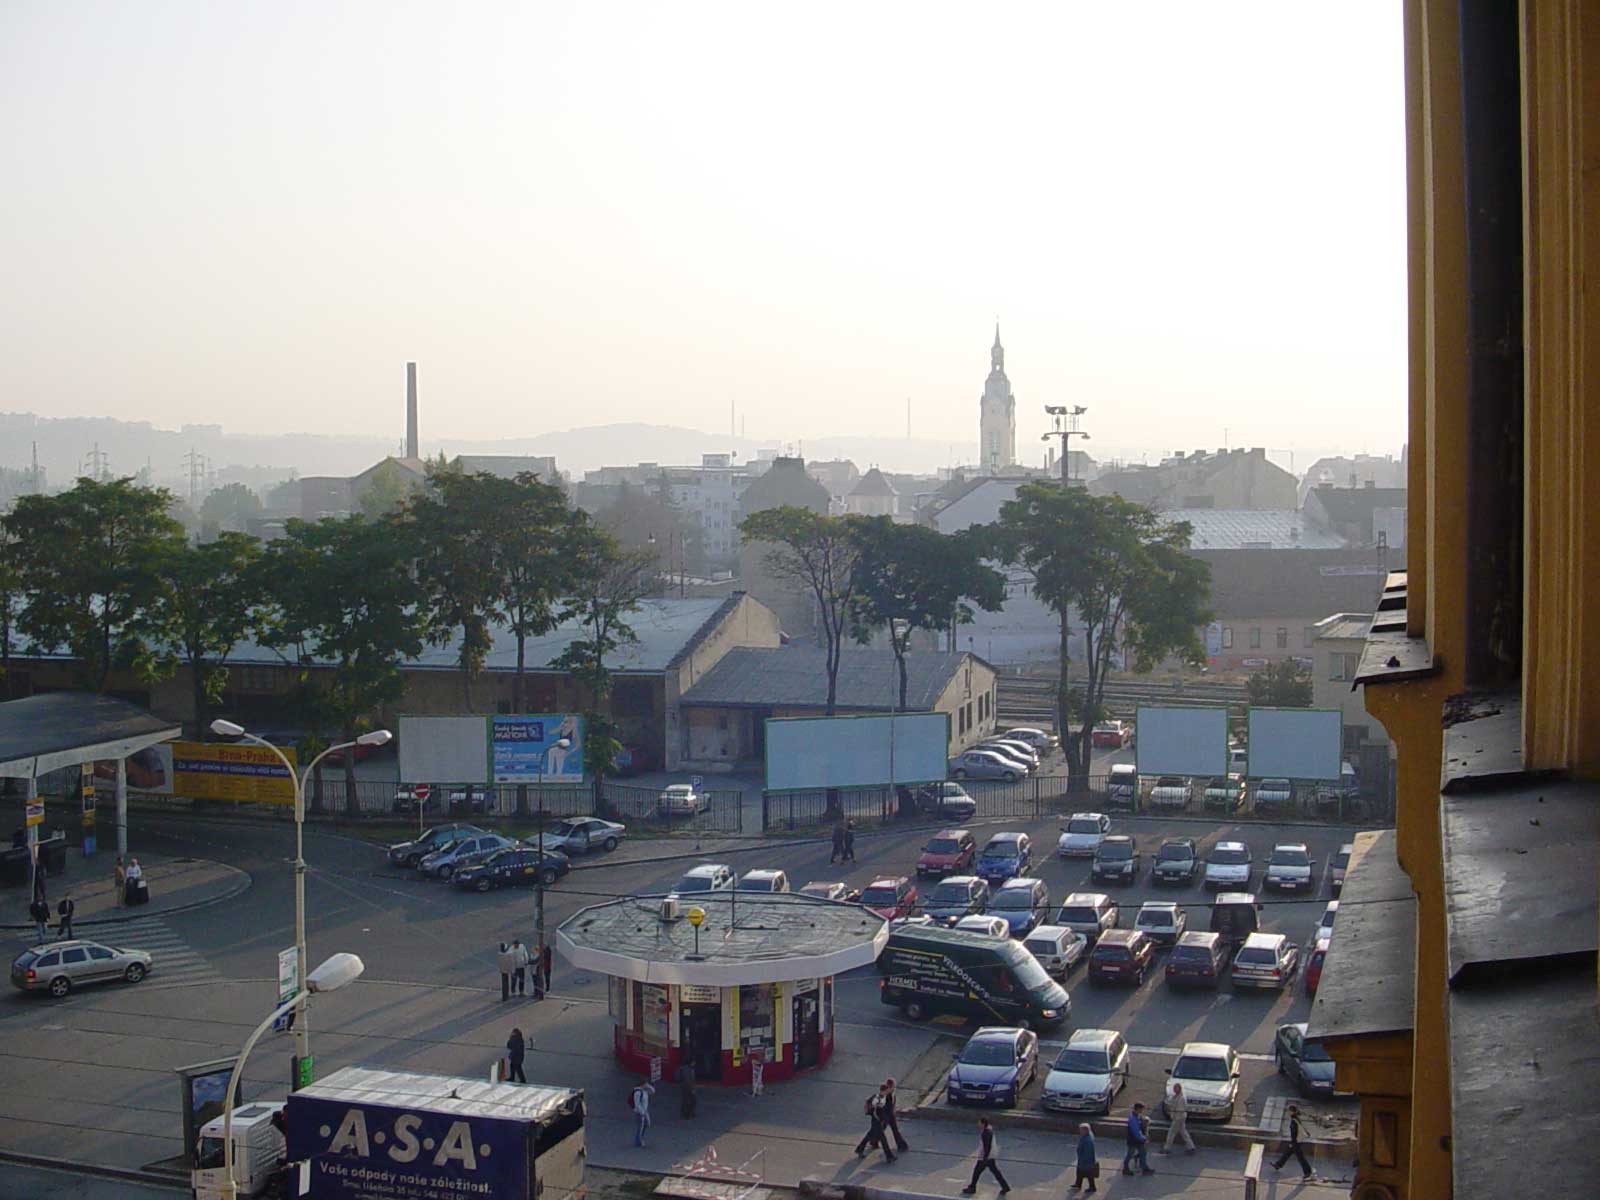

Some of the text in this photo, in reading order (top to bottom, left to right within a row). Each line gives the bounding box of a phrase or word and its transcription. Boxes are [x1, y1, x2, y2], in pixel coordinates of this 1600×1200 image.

[319, 1161, 348, 1176] Vaše
[351, 1165, 396, 1184] odpady
[400, 1173, 427, 1186] naše
